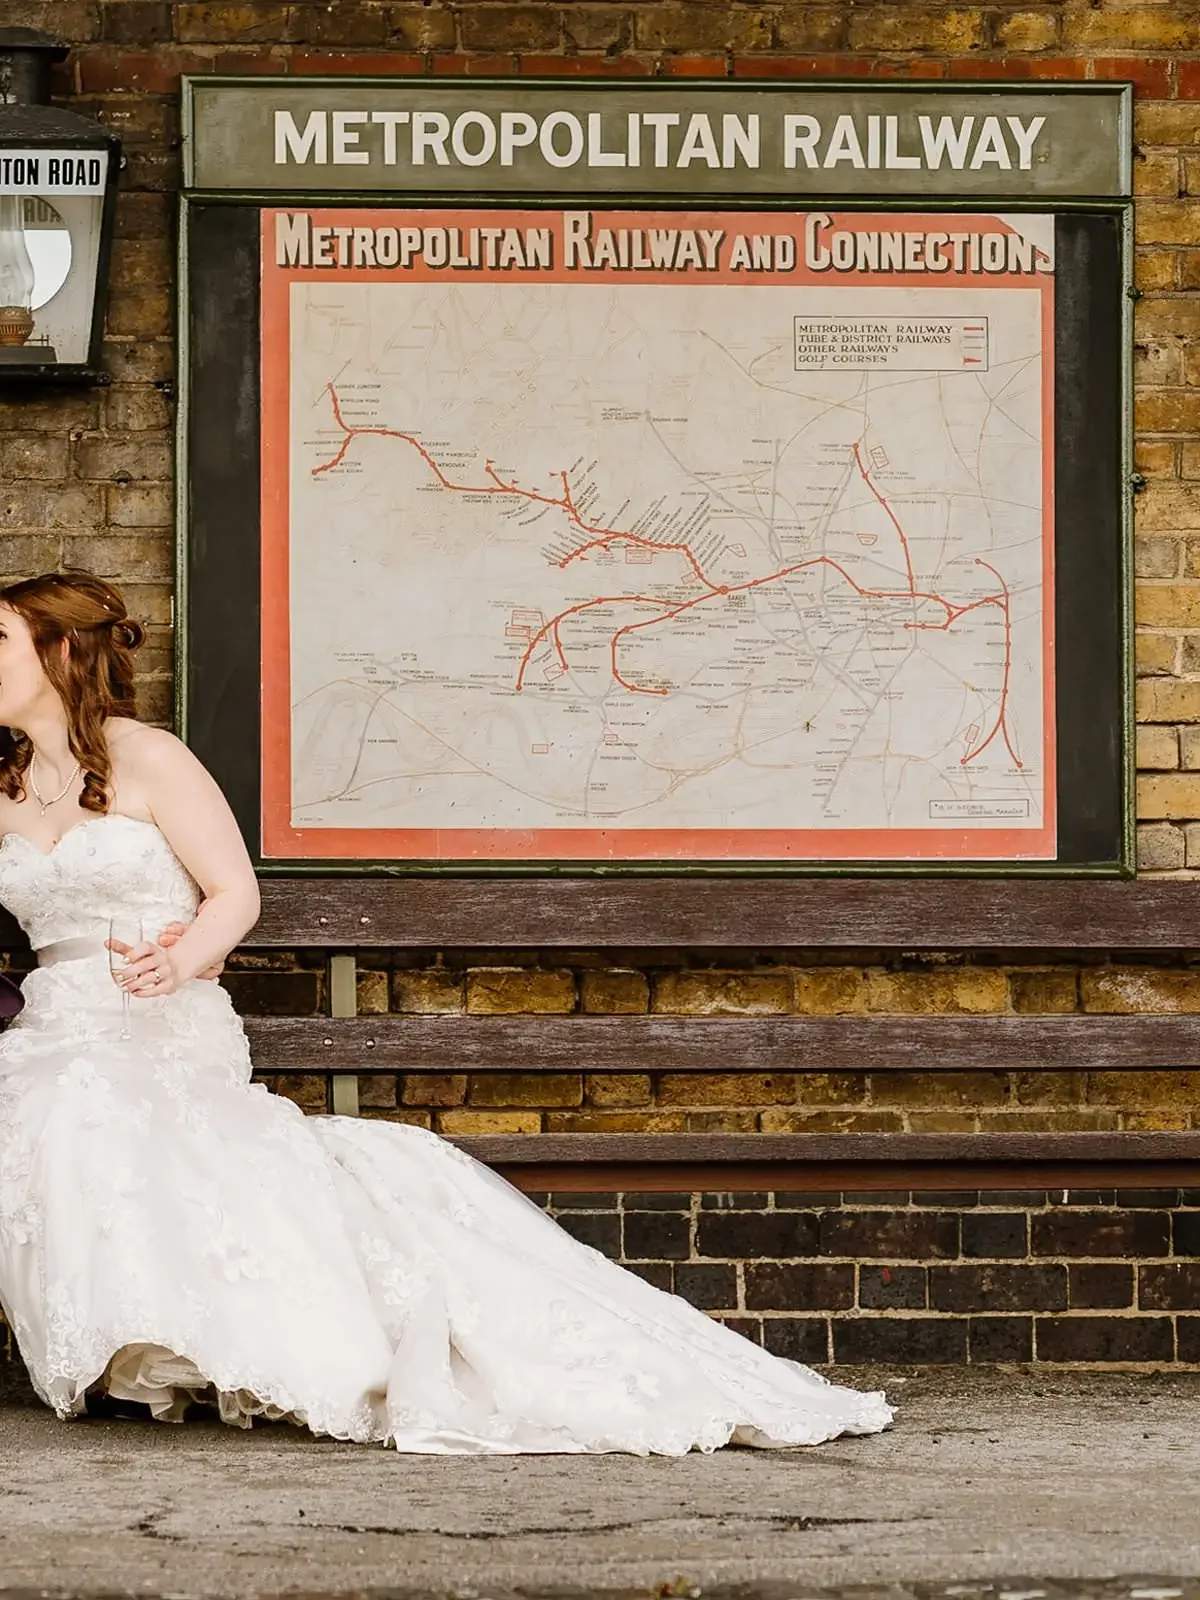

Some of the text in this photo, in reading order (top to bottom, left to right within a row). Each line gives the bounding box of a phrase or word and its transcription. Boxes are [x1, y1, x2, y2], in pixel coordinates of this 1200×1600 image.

[274, 110, 1047, 170] METROPOLITAN RAILWAY
[48, 158, 101, 186] ROAD
[275, 211, 553, 271] METROPOLITAN
[563, 210, 727, 271] RAILWAY
[730, 235, 797, 273] AND
[799, 325, 953, 334] METROPOLITAN RAILWAY
[799, 335, 952, 344] TUBE & DISTRICT RAILWAYS
[798, 345, 899, 354] OTHER RAILWAYS
[832, 354, 888, 363] COURSES
